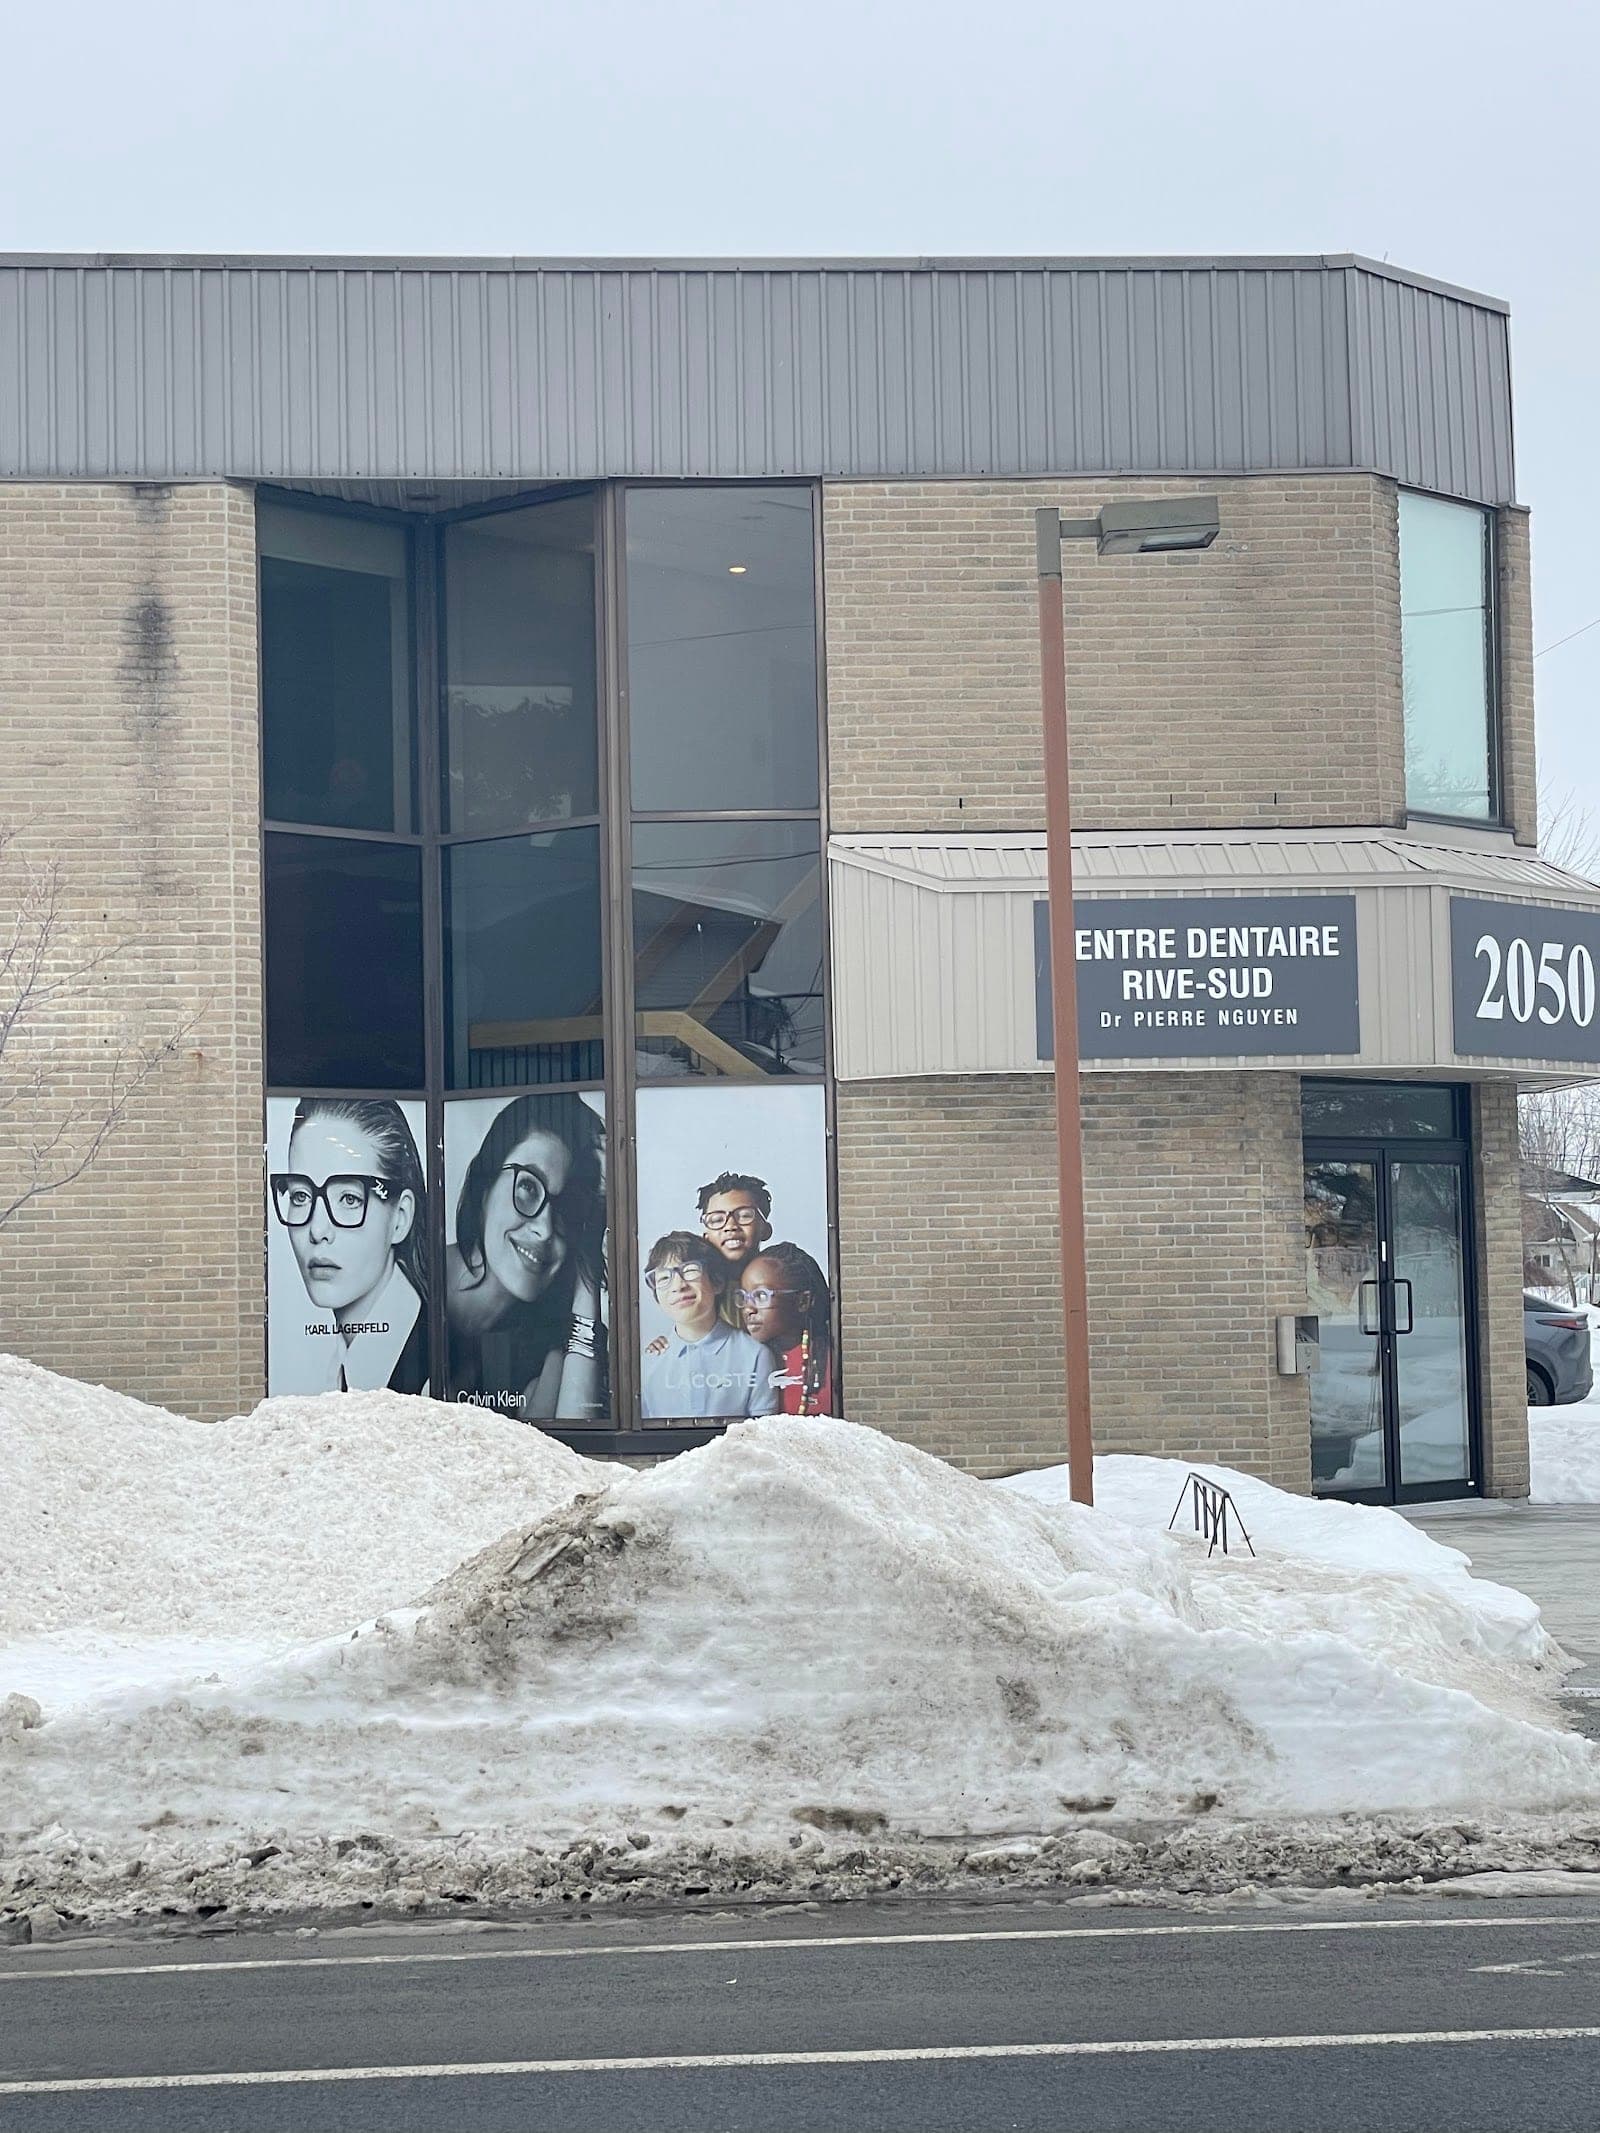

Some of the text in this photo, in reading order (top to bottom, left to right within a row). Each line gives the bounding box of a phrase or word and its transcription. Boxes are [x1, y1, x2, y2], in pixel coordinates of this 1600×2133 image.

[1074, 926, 1340, 961] ENTRE DENTAIRE
[1122, 967, 1273, 1001] RIVE-SUD
[1474, 934, 1596, 1028] 2050
[1100, 1008, 1299, 1028] Dr PIERRE NGUYEN
[305, 1322, 390, 1336] KARL LAGERFELD
[665, 1372, 758, 1388] LACOSTE
[456, 1390, 527, 1408] Calvin Klein
